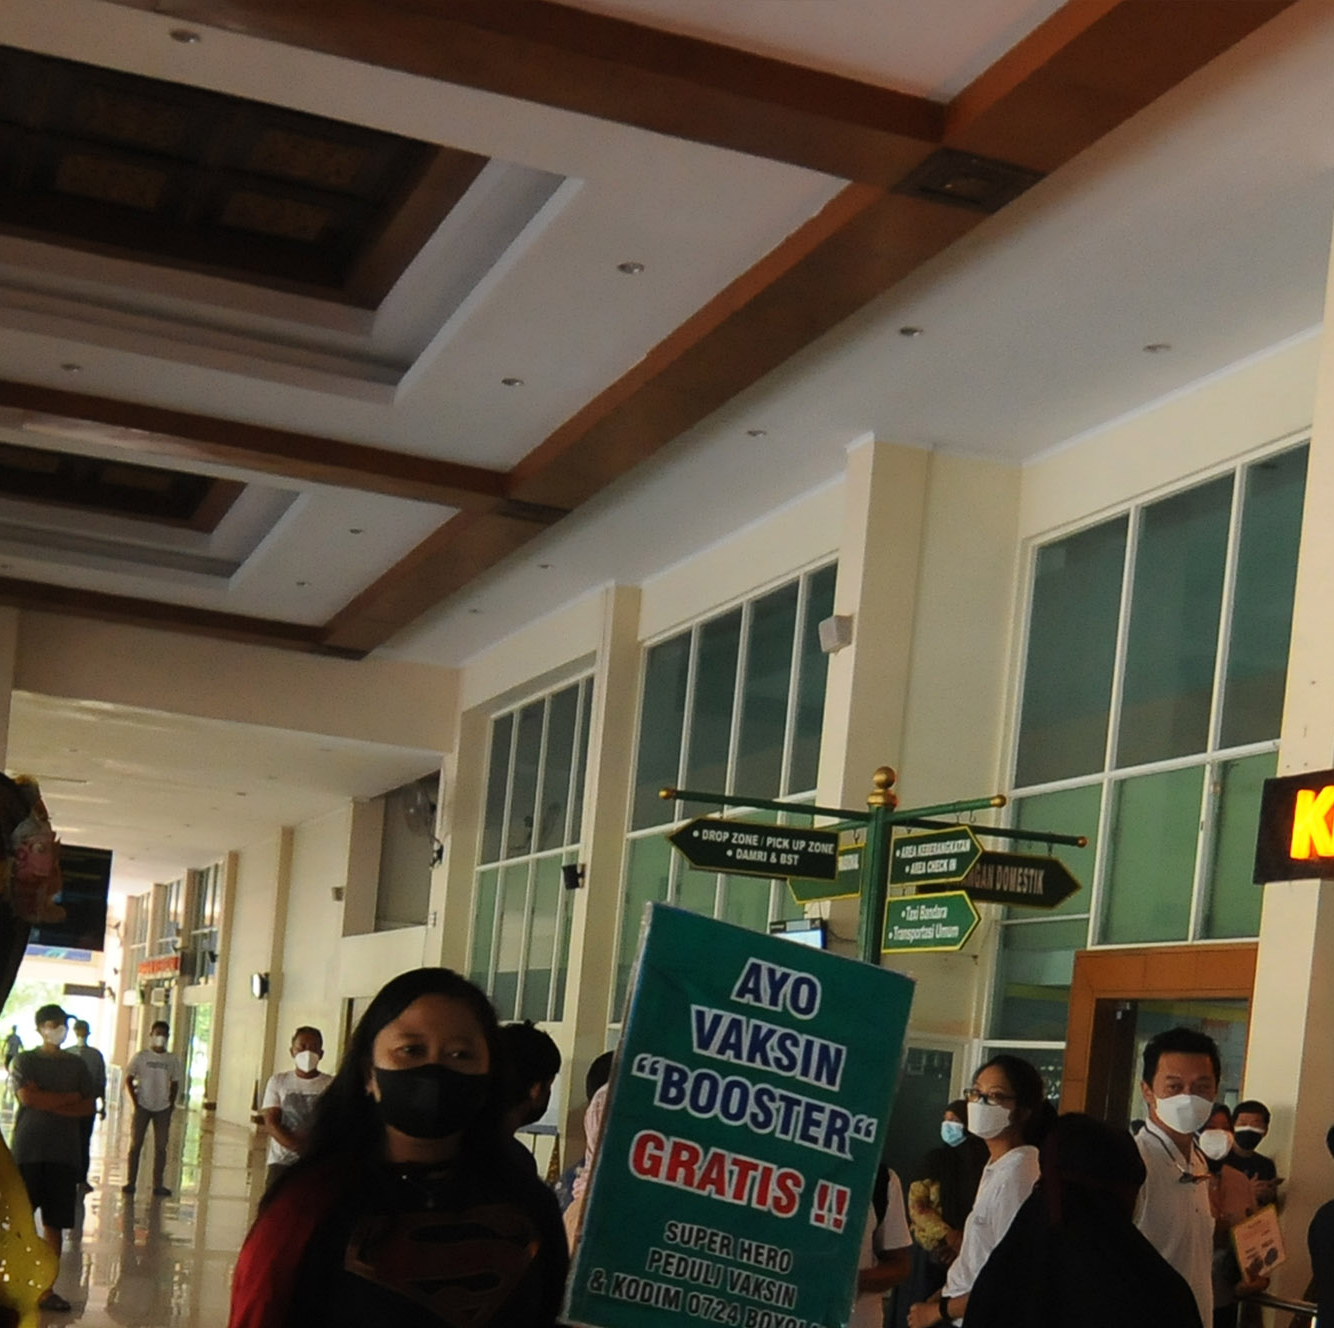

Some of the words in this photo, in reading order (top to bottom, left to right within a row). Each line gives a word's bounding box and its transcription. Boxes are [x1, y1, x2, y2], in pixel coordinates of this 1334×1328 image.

[701, 829, 729, 843] DROP
[731, 832, 759, 847] ZONE
[766, 837, 790, 850] PICK
[792, 839, 806, 851] UP
[807, 841, 835, 855] ZONE
[735, 848, 767, 863] DAMRI
[769, 851, 777, 864] &
[780, 852, 800, 866] BST
[900, 844, 916, 859] AREA
[910, 861, 926, 875] AREA
[927, 859, 948, 873] CHECK
[949, 858, 957, 871] IN
[996, 864, 1045, 896] DOMESTIK
[920, 905, 948, 921] Bandara
[893, 924, 935, 943] Transportasi
[936, 923, 960, 939] Umum
[732, 957, 821, 1020] AYO
[691, 1004, 847, 1092] VAKSIN
[629, 1130, 805, 1220] GRATIS
[810, 1179, 851, 1234] !!
[665, 1221, 732, 1257] SUPER
[739, 1238, 793, 1273] HERO
[647, 1248, 721, 1286] PEDULI
[728, 1270, 797, 1308] VAKSIN
[590, 1269, 605, 1293] &
[612, 1272, 681, 1310] KODIM
[688, 1294, 739, 1327] 0724
